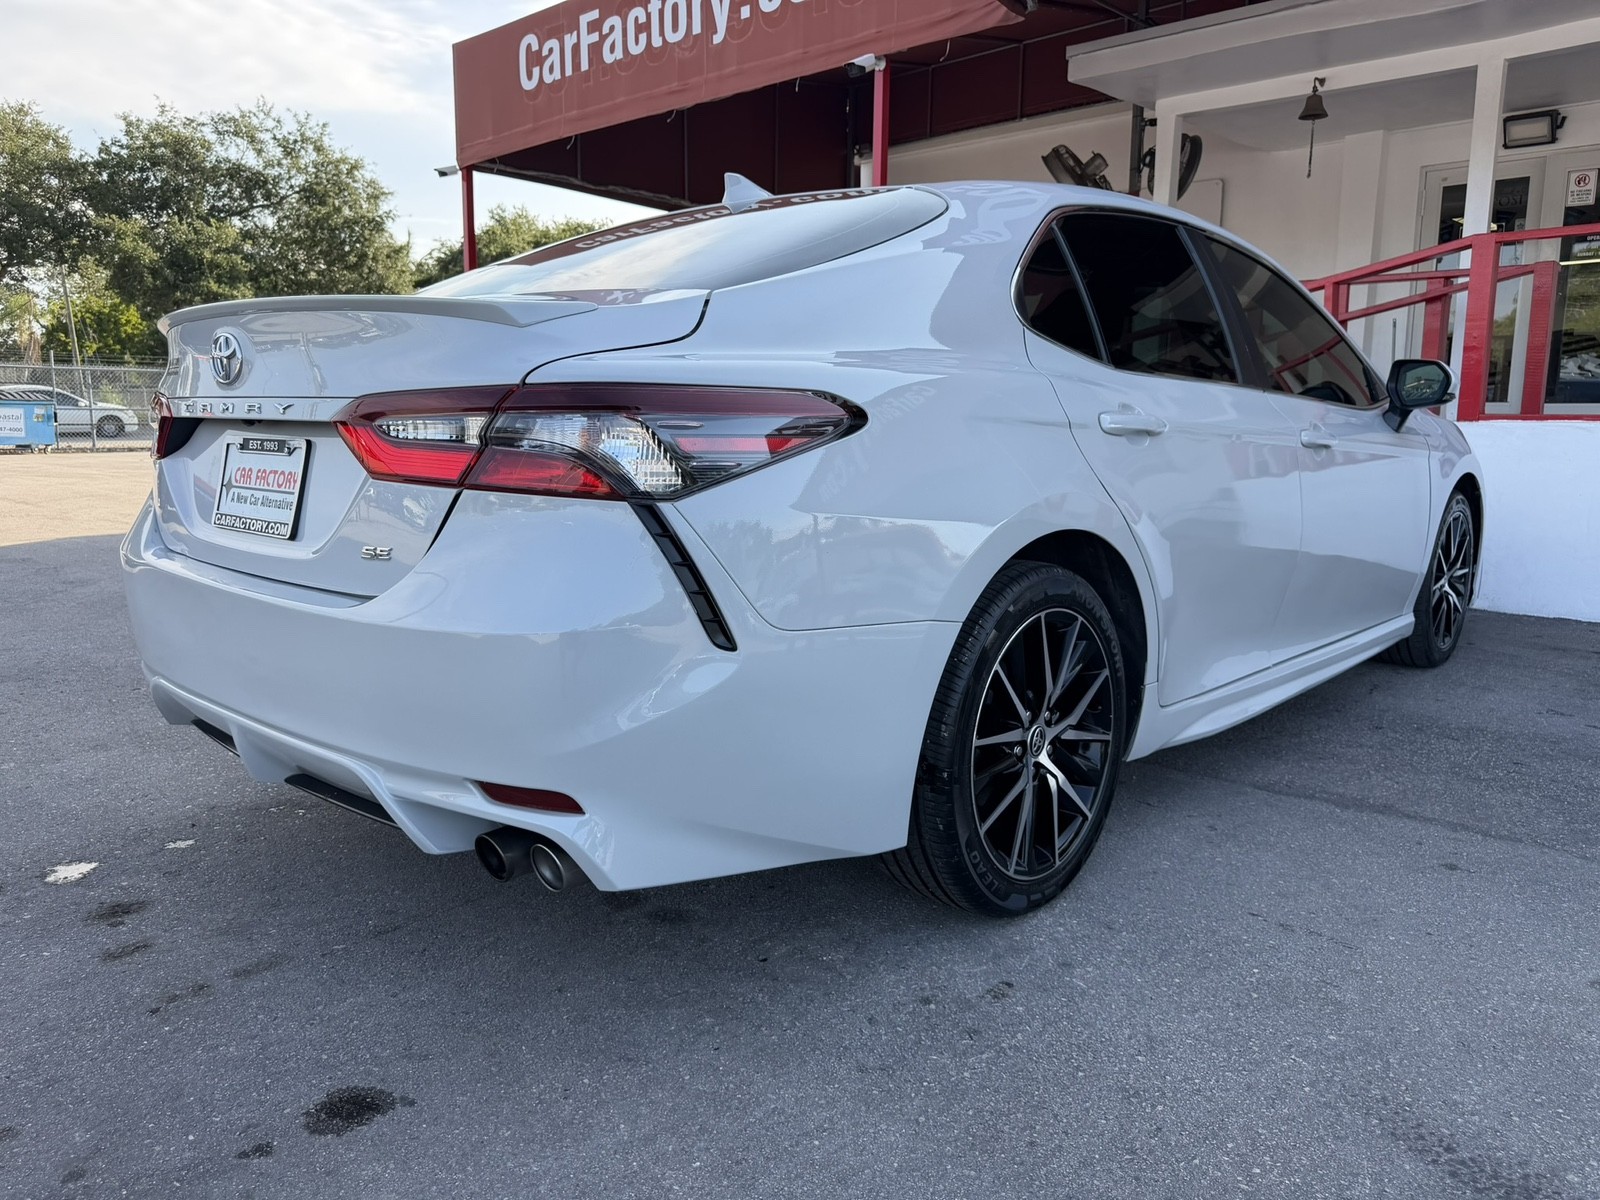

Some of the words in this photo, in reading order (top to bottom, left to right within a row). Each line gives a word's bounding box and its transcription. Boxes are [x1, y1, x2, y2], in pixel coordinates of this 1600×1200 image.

[519, 0, 801, 91] CarFactory.
[184, 402, 295, 415] CAMRY
[249, 440, 262, 450] EST.
[263, 441, 278, 450] 1993
[234, 466, 253, 486] CAR
[254, 468, 299, 490] FACTORY
[230, 491, 236, 503] A
[236, 492, 248, 504] New
[249, 494, 260, 506] Car
[260, 494, 294, 511] Alternative
[215, 514, 289, 536] CARFACTORY.COM
[361, 546, 392, 560] SE
